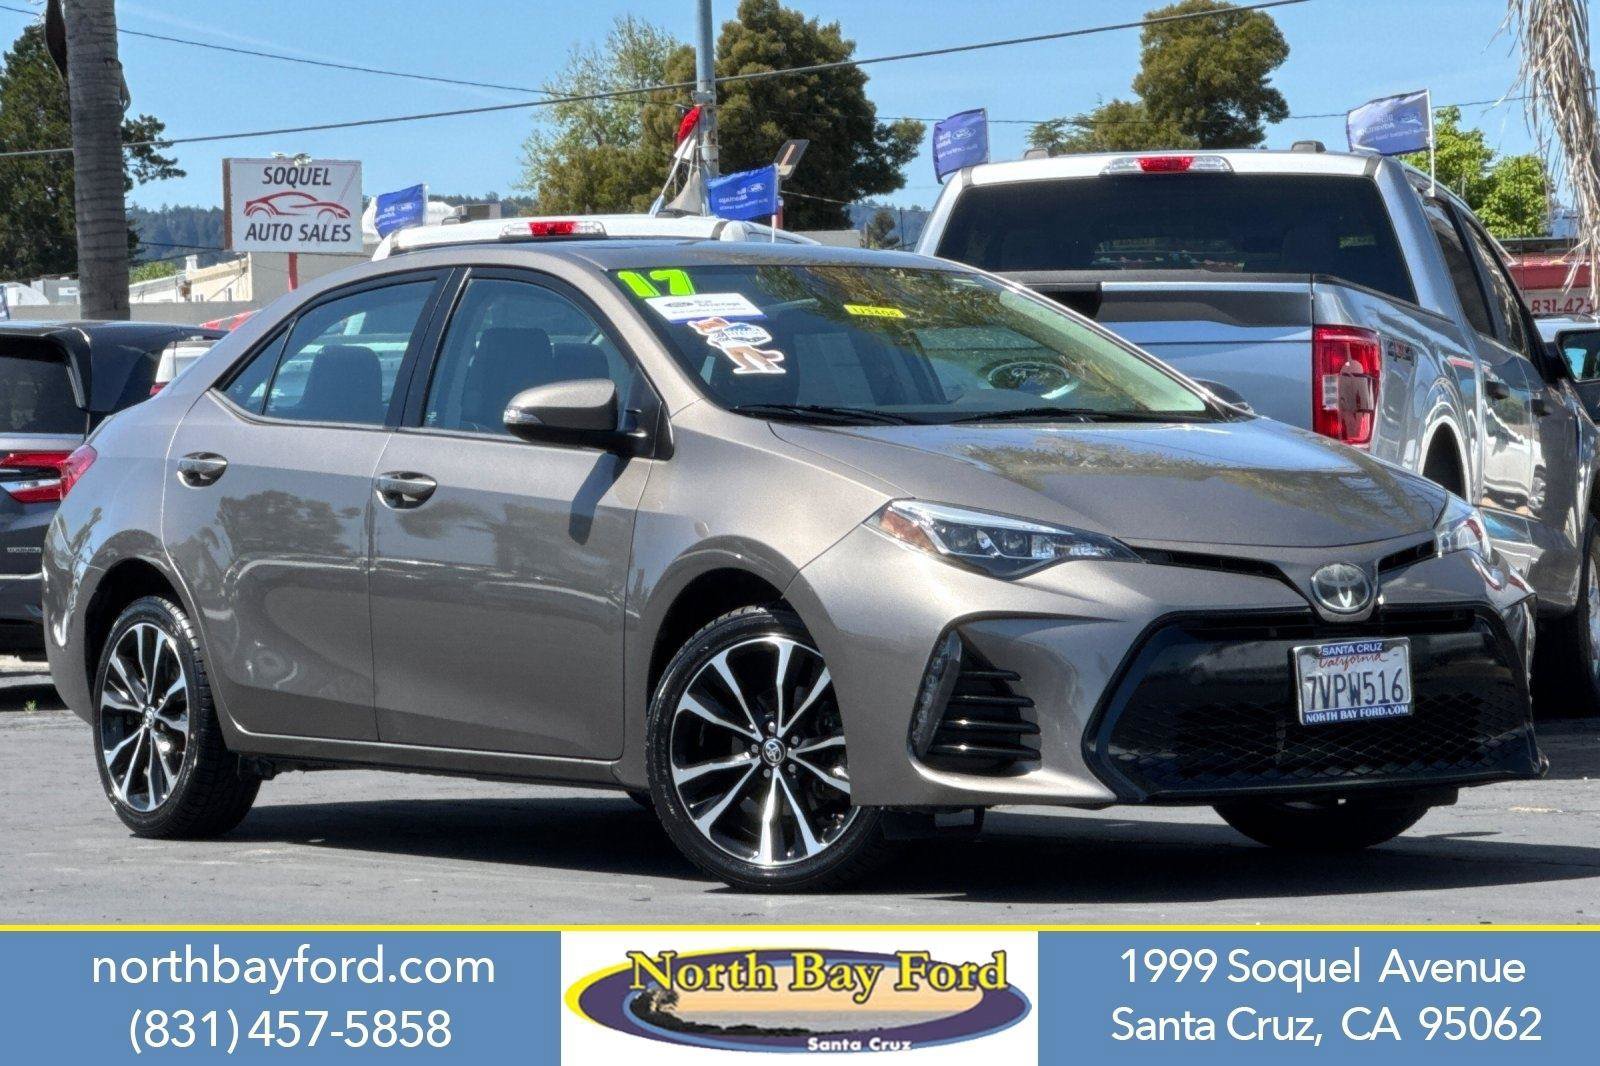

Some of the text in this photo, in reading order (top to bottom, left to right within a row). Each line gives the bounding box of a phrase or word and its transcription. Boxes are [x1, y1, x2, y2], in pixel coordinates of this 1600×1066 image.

[262, 166, 331, 188] SOQUEL
[245, 223, 351, 242] AUTO SALES
[618, 269, 695, 297] 17
[1322, 642, 1383, 656] SANTA CRUZ
[1304, 667, 1404, 710] 7VPW516
[1305, 704, 1409, 723] NORTH BAY FORD.COM
